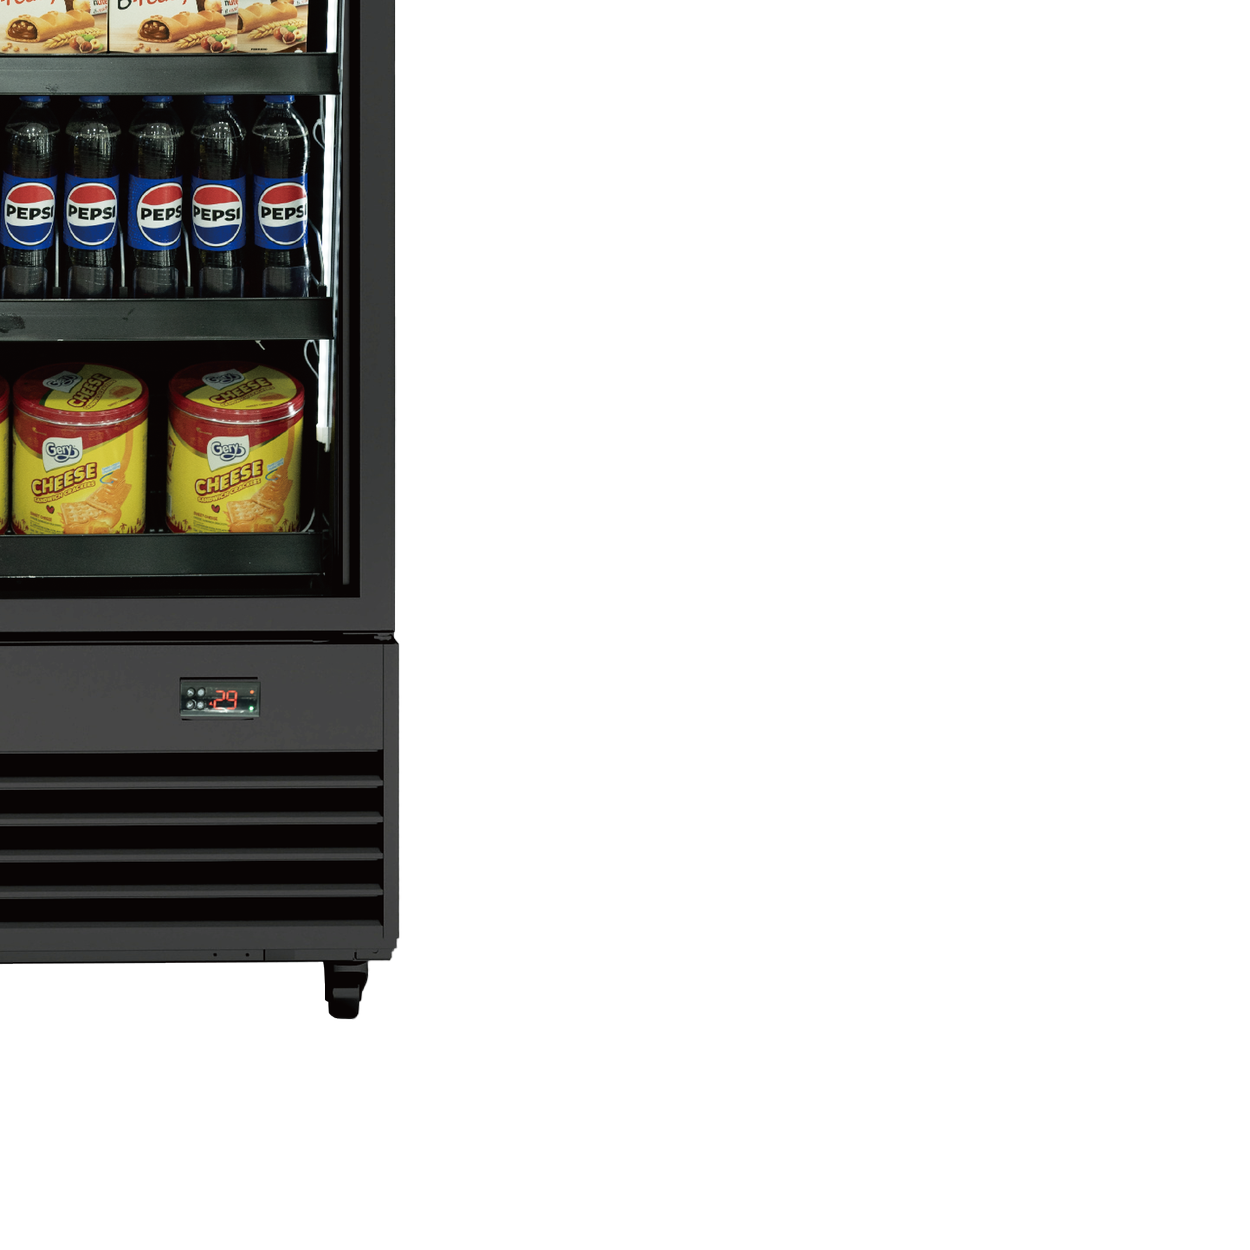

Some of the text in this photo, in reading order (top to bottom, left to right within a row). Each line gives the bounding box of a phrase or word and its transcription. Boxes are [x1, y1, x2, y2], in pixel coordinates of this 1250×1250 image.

[7, 204, 54, 220] PEPSI
[68, 204, 116, 221] PEPSI
[193, 205, 240, 222] PEPSI
[67, 373, 111, 408] CHEESE
[209, 377, 272, 403] CHEESE
[46, 442, 80, 463] Gery
[210, 441, 246, 462] Gery
[31, 462, 97, 497] CHEESE
[195, 459, 263, 496] CHEESE
[34, 491, 63, 504] SANDWICH
[197, 491, 230, 504] SANDWICH
[213, 689, 238, 710] 29
